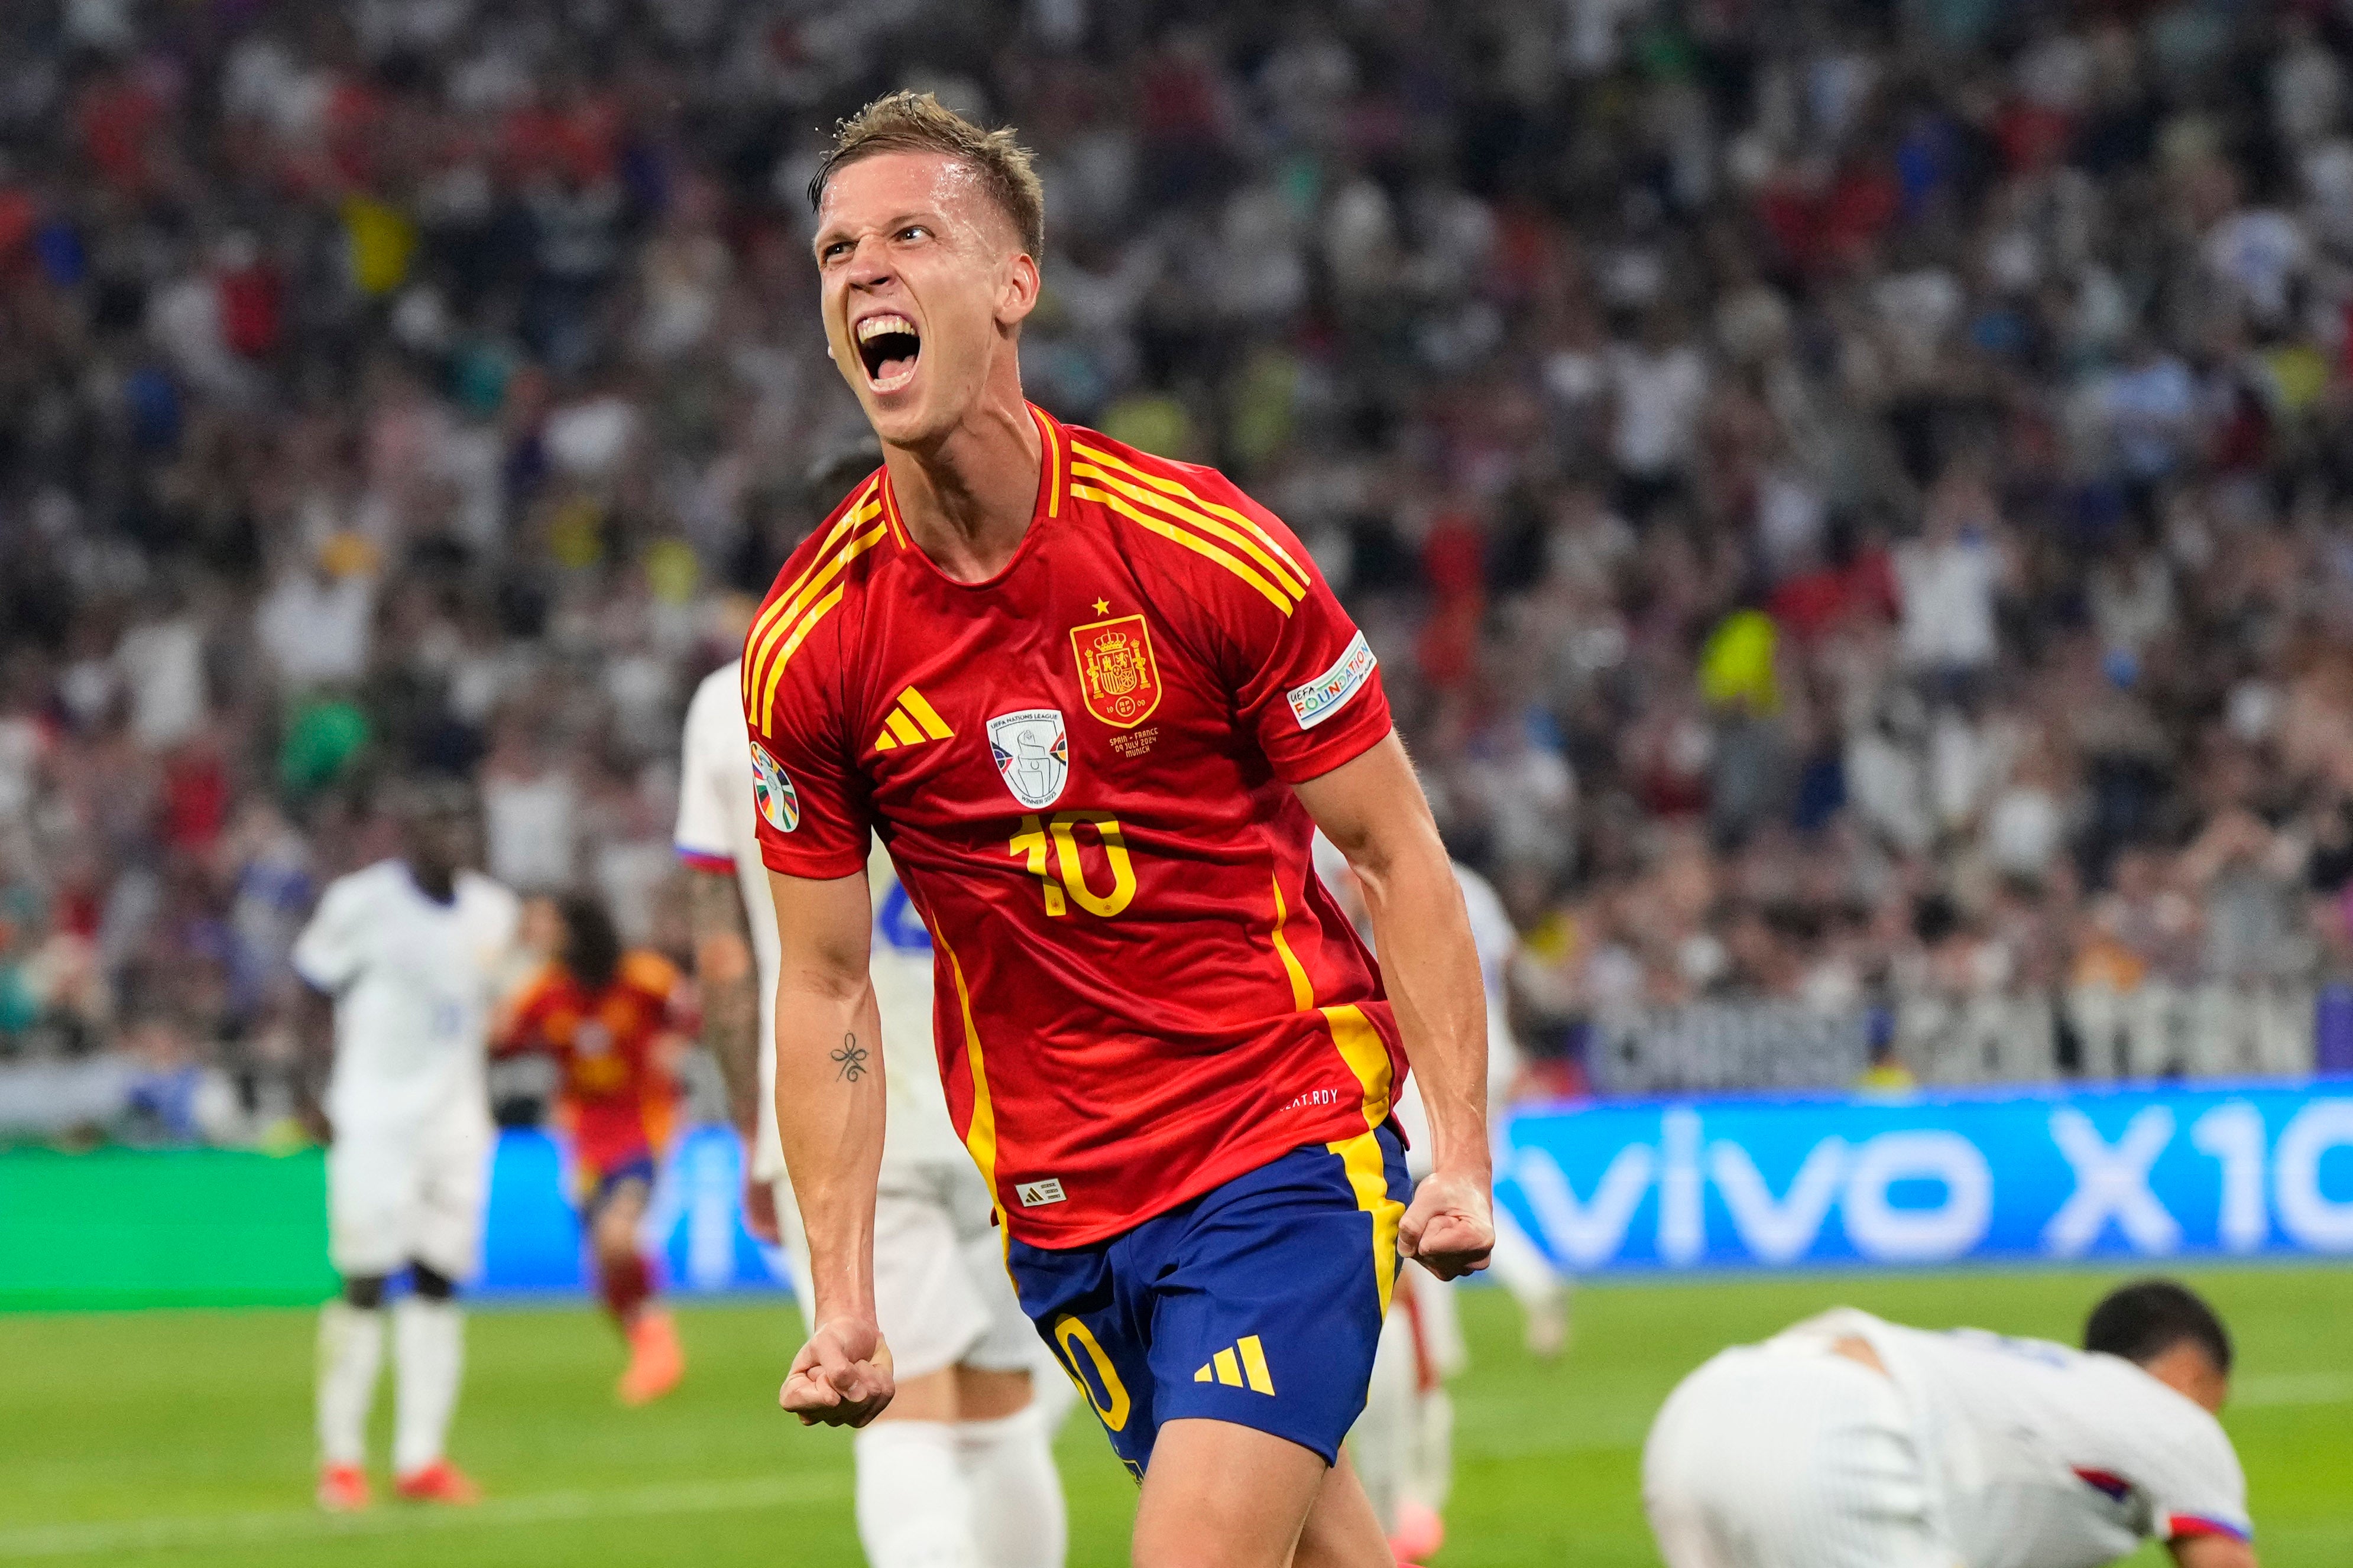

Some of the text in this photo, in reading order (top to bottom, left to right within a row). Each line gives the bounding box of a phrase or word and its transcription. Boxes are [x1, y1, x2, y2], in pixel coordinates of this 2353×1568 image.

[1294, 642, 1369, 717] FOUNDATION
[1291, 686, 1315, 703] UEFA
[1006, 714, 1033, 723] NATIONS
[1109, 735, 1128, 746] SPAIN
[1134, 727, 1158, 740] FRANCE
[1115, 736, 1156, 752] 09 JULY 2024
[1125, 745, 1150, 758] MUNICH
[1022, 795, 1043, 804] WINNER
[1009, 810, 1137, 917] 10
[1279, 1089, 1338, 1112] AT.RDY
[1513, 1106, 1995, 1264] vivo
